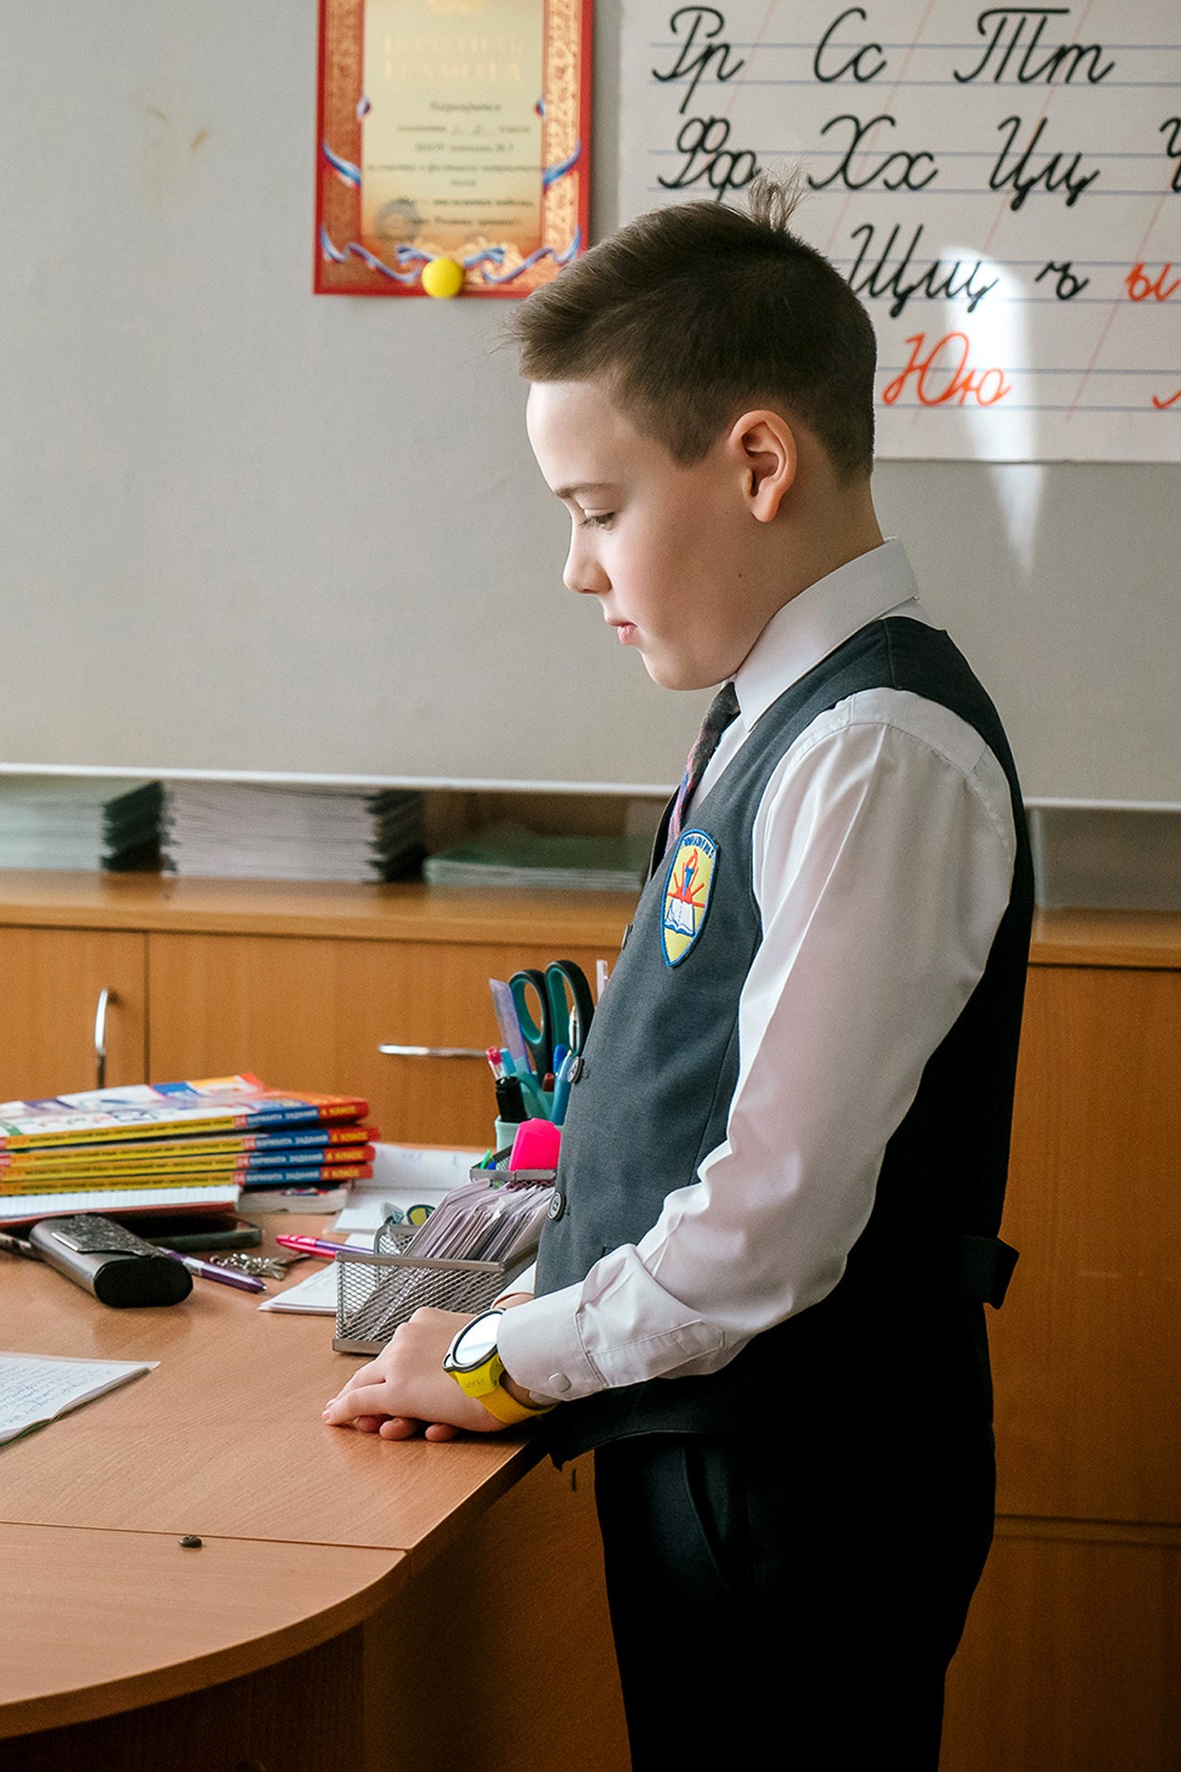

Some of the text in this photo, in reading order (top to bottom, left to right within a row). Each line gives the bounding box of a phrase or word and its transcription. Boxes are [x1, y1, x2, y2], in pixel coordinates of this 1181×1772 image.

[652, 6, 1116, 115] Рр Сс Тт
[657, 115, 759, 202] Фф
[807, 114, 939, 192] Хх
[988, 115, 1101, 212] Цц
[849, 223, 1181, 318] Щщ ъ ы
[882, 331, 1012, 408] Юю
